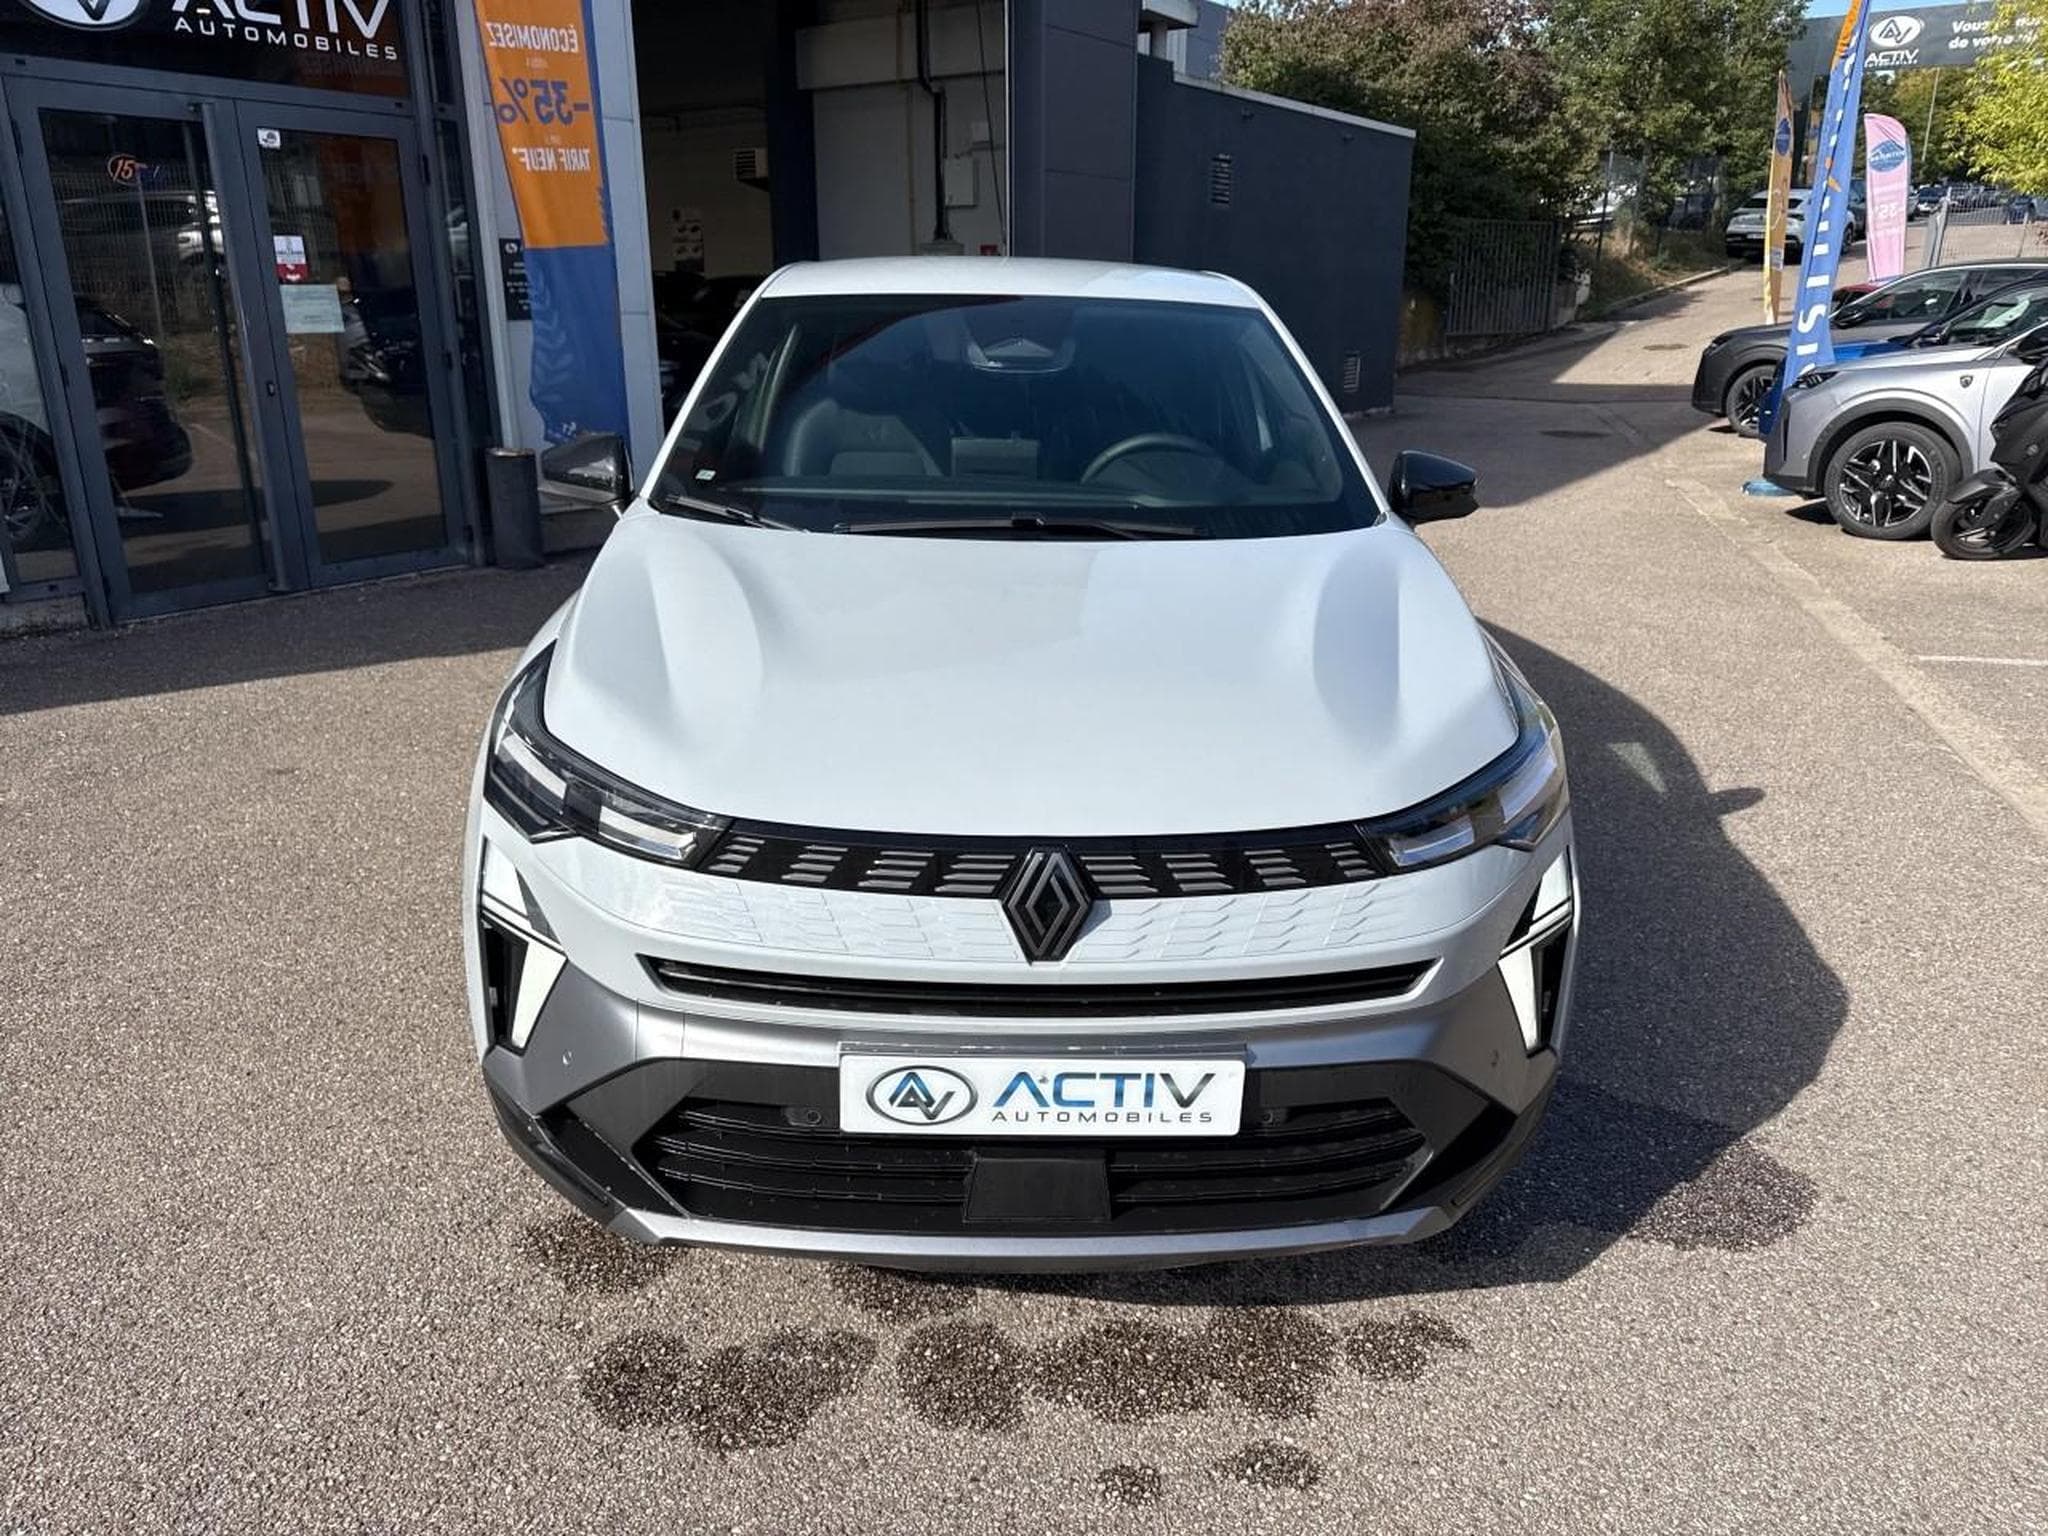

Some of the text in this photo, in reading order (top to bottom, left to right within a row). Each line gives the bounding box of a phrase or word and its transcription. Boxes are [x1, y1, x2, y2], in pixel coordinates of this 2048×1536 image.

[174, 16, 398, 60] AUTOMOBILES
[1864, 48, 1920, 66] ACTIV
[993, 1071, 1216, 1109] ACTIV
[992, 1111, 1213, 1125] AUTOMOBILES
